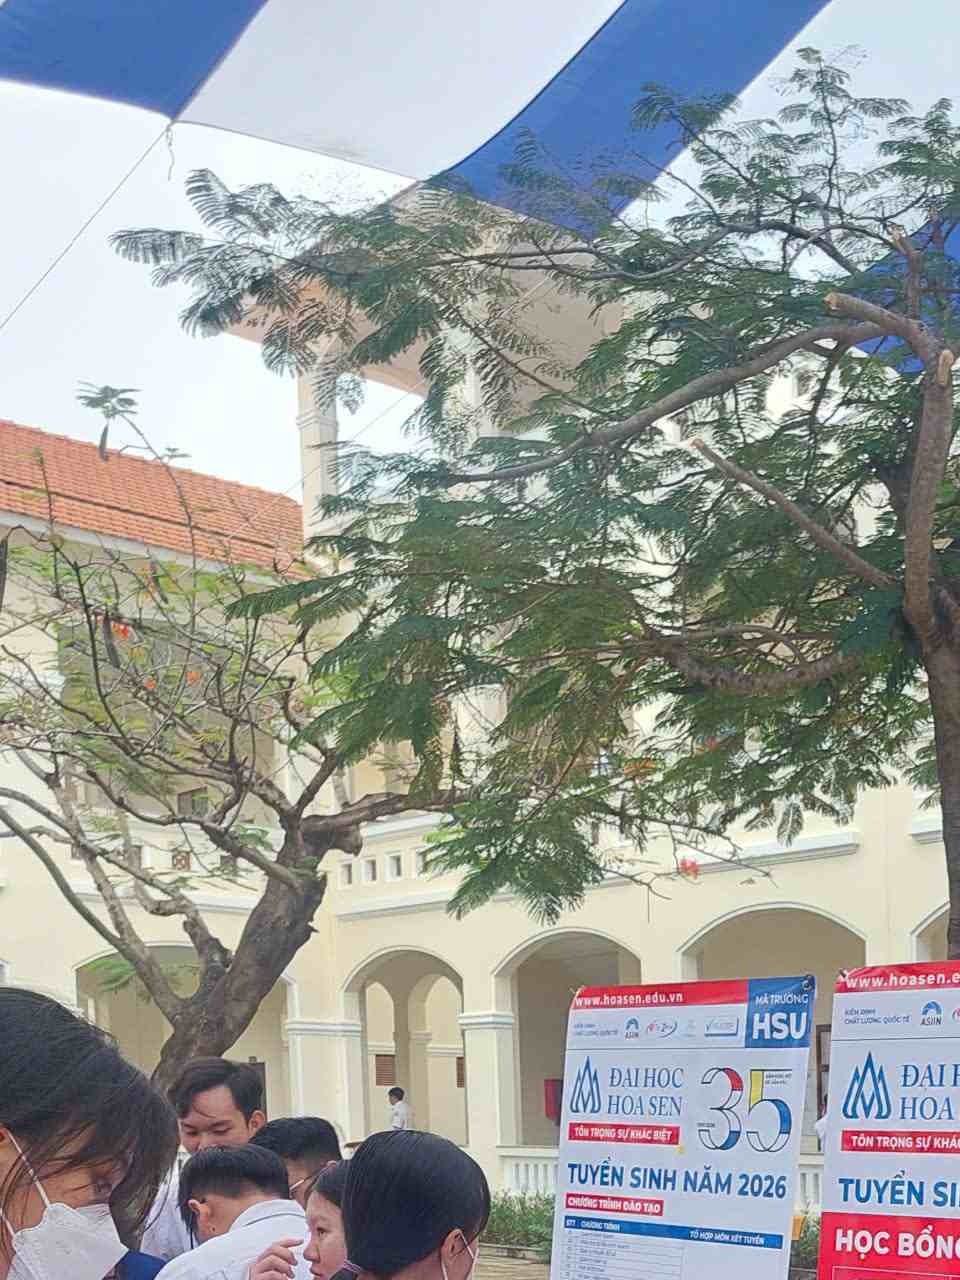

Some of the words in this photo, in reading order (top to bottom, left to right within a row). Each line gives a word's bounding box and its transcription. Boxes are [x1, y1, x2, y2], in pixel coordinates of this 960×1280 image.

[574, 992, 683, 1007] www.hoasen.edu.vn
[771, 991, 809, 1005] TRƯỜNG
[752, 1011, 808, 1040] HSU
[900, 1064, 946, 1091] ĐẠI
[606, 1095, 643, 1116] HOA
[648, 1096, 683, 1117] SEN
[697, 1066, 793, 1152] 35
[900, 1096, 957, 1121] HOA
[574, 1125, 589, 1137] TÔN
[590, 1127, 616, 1140] TRỌNG
[630, 1127, 652, 1140] KHÁC
[653, 1128, 673, 1142] BIỆT
[851, 1133, 874, 1149] TÔN
[877, 1135, 913, 1153] TRỌNG
[916, 1134, 932, 1151] SỰ
[567, 1152, 625, 1187] TUYỂN
[629, 1167, 677, 1191] SINH
[683, 1166, 732, 1195] NĂM
[738, 1174, 787, 1199] 2026
[838, 1171, 926, 1208] TUYỂN
[567, 1196, 598, 1209] CHƯƠNG
[599, 1197, 622, 1210] TRÌNH
[622, 1200, 641, 1213] ĐÀO
[642, 1202, 661, 1216] TẠO
[835, 1228, 889, 1258] HỌC
